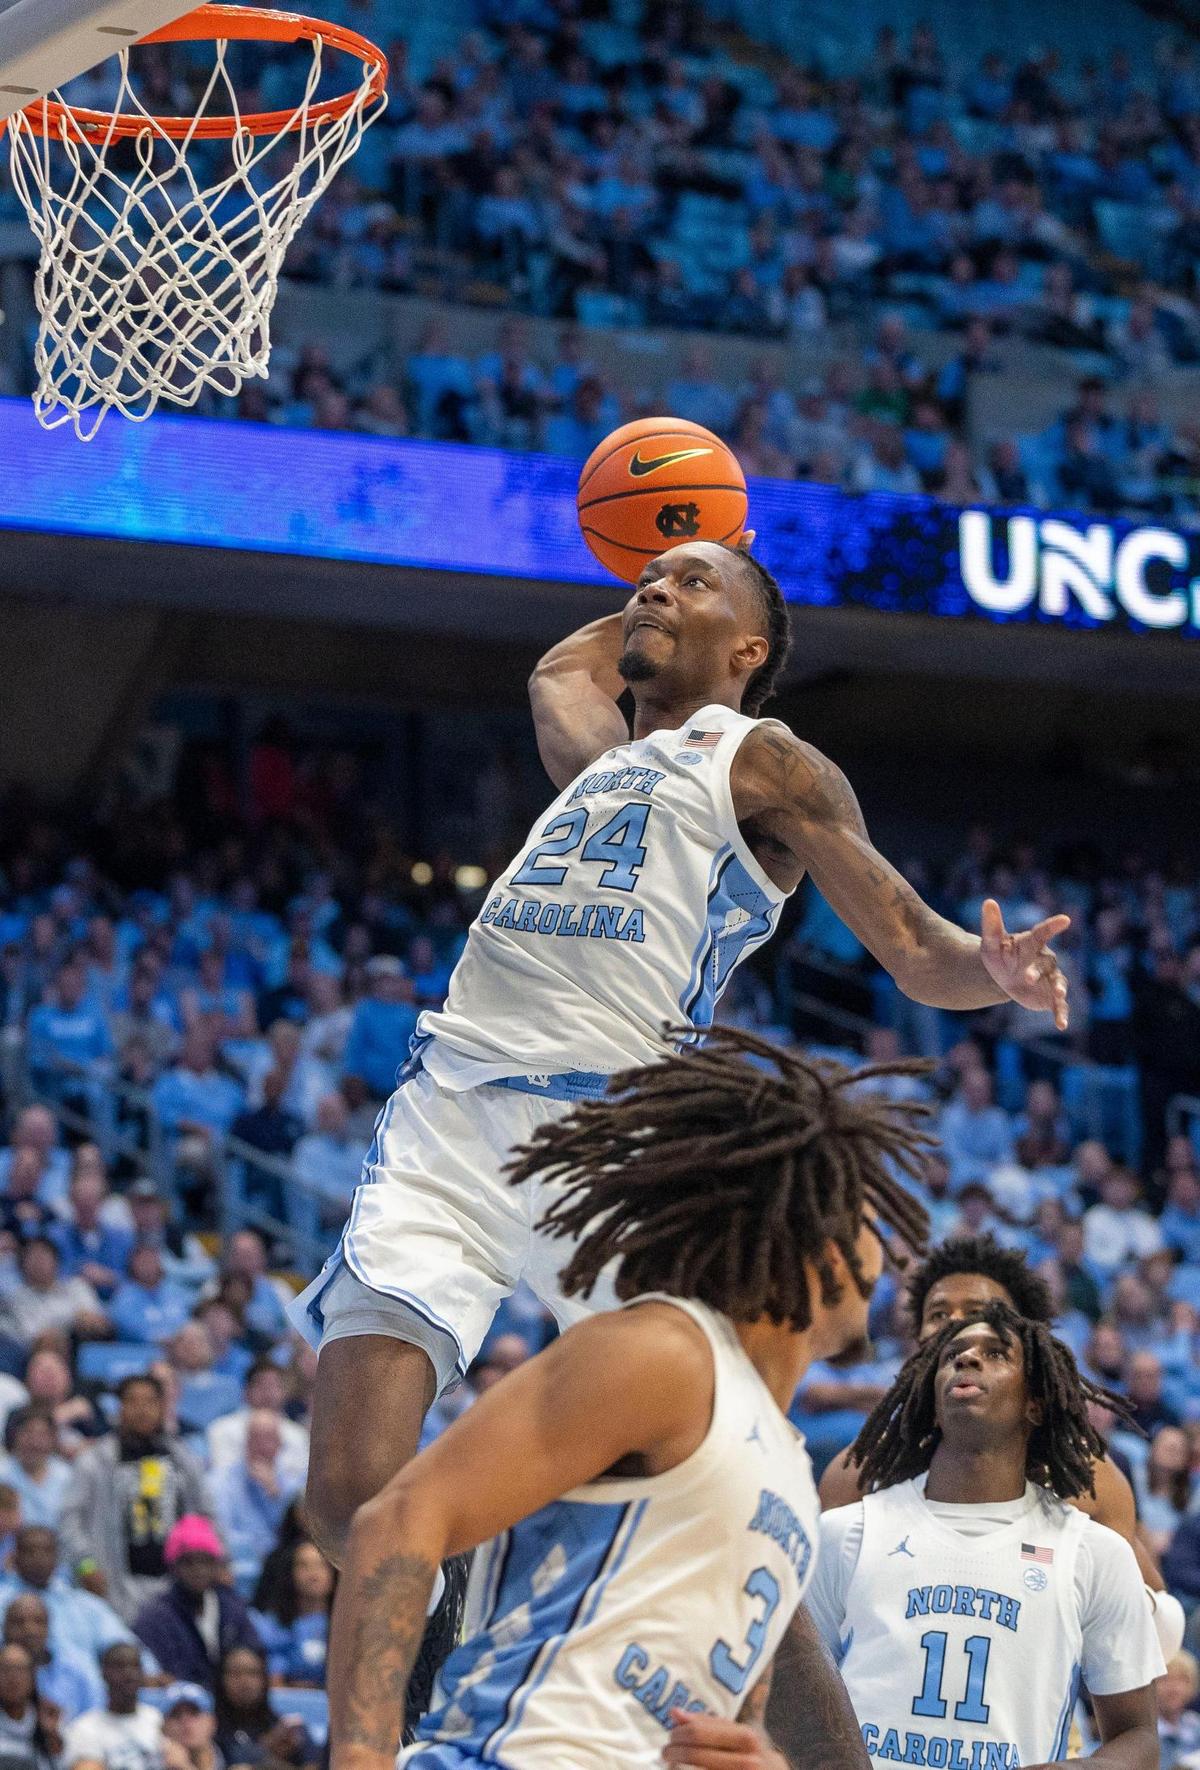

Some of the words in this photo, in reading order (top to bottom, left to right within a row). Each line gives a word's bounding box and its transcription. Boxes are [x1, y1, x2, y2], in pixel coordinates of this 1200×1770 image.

[565, 766, 667, 807] NORTH
[509, 802, 652, 892] 24
[480, 896, 646, 943] CAROLINA
[747, 1488, 811, 1588] NORTH
[709, 1565, 781, 1695] 3
[904, 1584, 1022, 1632] NORTH
[614, 1642, 707, 1731] CAR
[912, 1630, 991, 1724] 11
[861, 1722, 1021, 1770] CAROLINA
